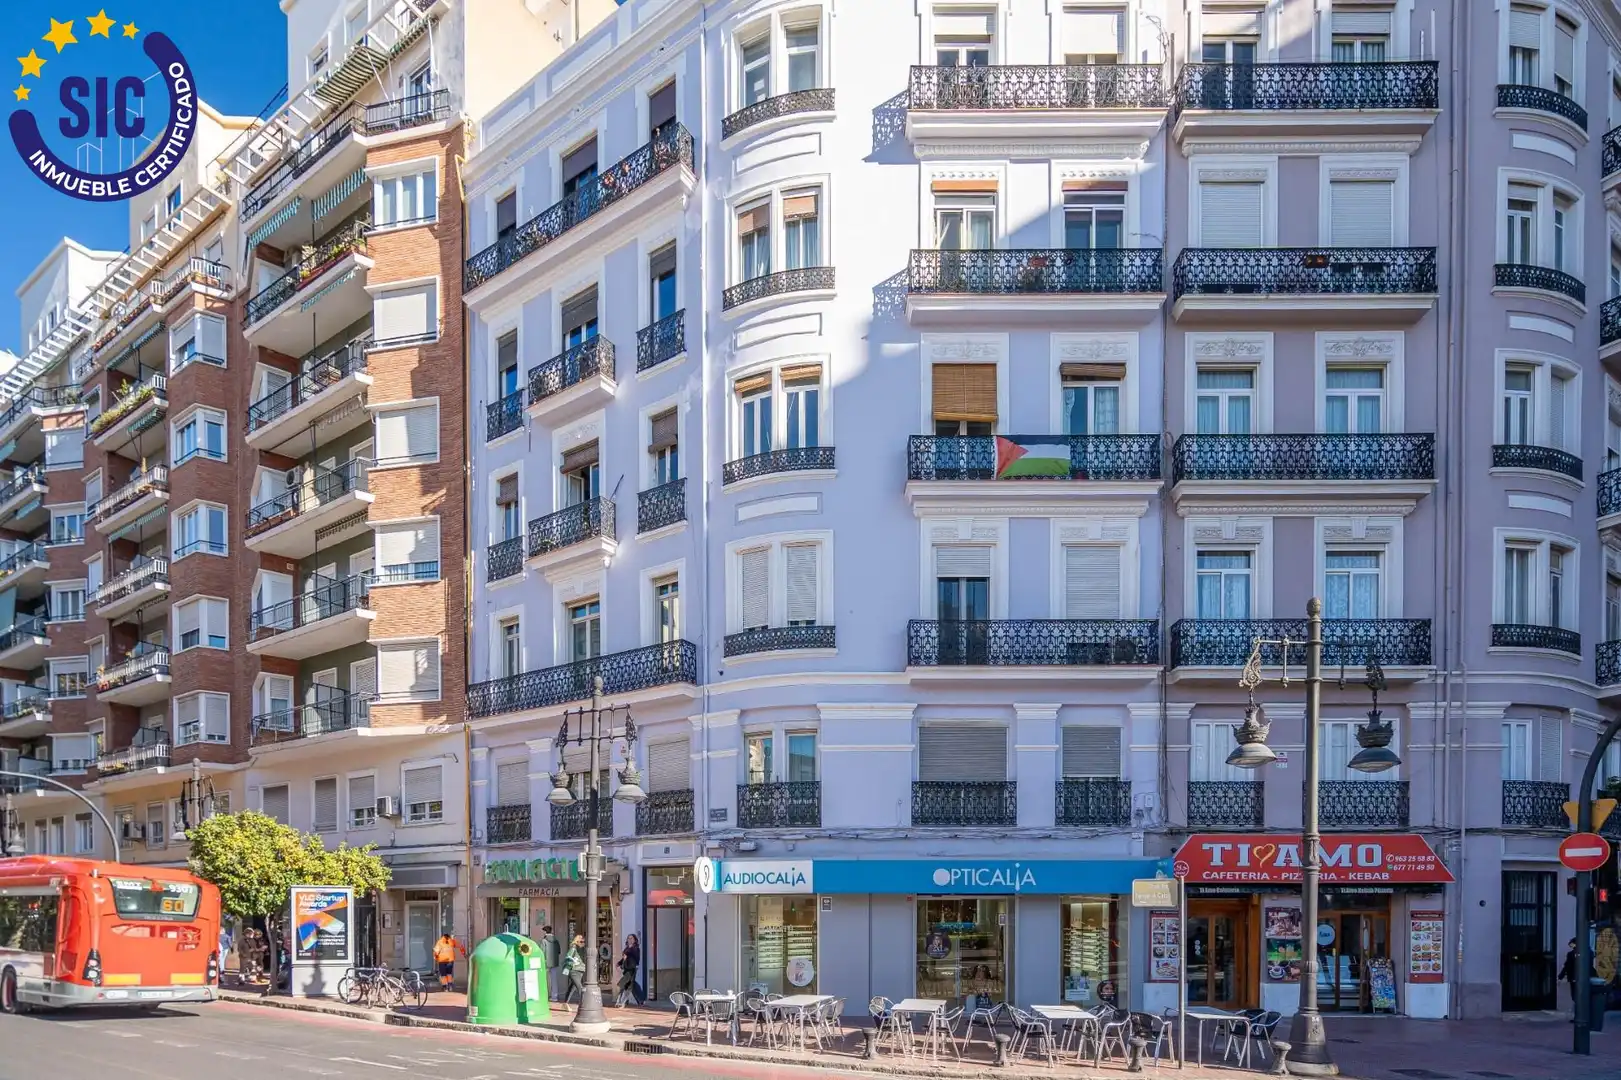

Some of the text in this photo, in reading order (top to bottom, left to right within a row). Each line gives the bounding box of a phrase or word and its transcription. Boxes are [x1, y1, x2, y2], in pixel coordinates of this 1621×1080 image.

[1202, 871, 1270, 880] CAFETERIA
[1348, 871, 1391, 880] KEBAB
[518, 888, 561, 897] FARMACIA
